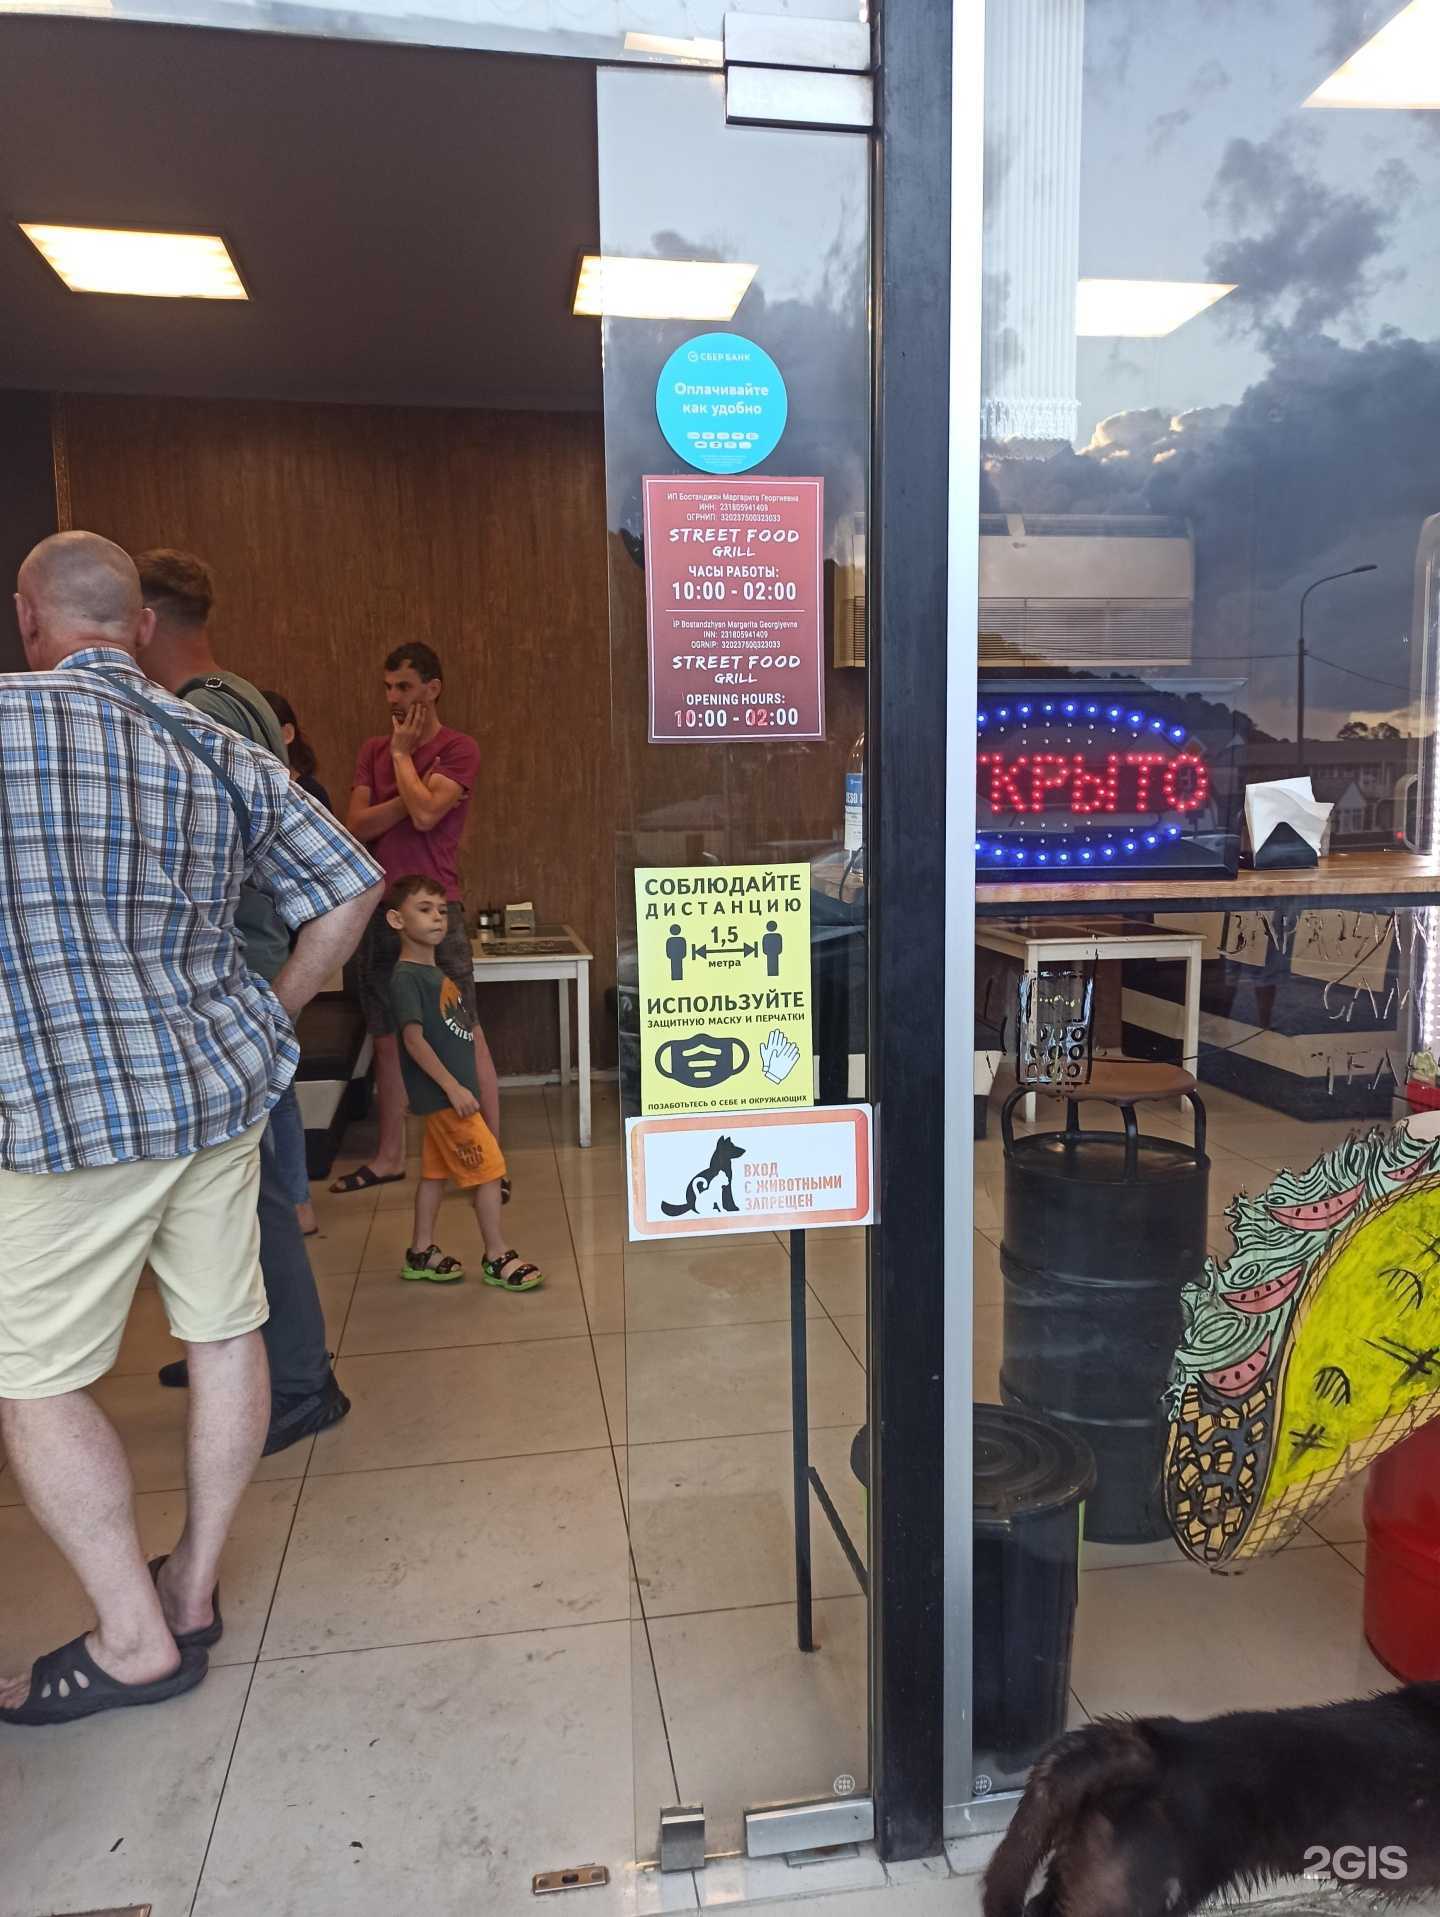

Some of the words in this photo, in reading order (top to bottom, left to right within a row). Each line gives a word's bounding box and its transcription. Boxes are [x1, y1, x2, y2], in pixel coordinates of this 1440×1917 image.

[674, 382, 769, 396] Оплачивайте
[683, 402, 707, 414] как
[712, 401, 762, 416] удобно
[723, 493, 759, 502] Маргарита
[669, 528, 740, 543] STREET
[747, 529, 800, 543] FOOD
[713, 546, 756, 557] GRILL
[689, 565, 723, 578] ЧАСЫ
[727, 565, 779, 578] РАБОТЫ:
[672, 581, 725, 600] 10:00
[744, 582, 796, 600] 02:00
[672, 655, 743, 670] STREET
[748, 656, 801, 669] FOOD
[714, 673, 758, 684] GRILL
[686, 694, 738, 705] OPENING
[742, 693, 785, 704] HOURS:
[675, 709, 726, 727] 10:00
[746, 708, 798, 726] 02:00
[644, 872, 801, 896] СОБЛЮДАЙТЕ
[645, 898, 801, 920] ДИСТАНЦИЮ
[711, 926, 738, 947] 1,5
[708, 958, 741, 969] метра
[647, 989, 804, 1015] ИСПОЛЬЗУЙТЕ
[648, 1017, 704, 1028] ЗАЩИТНУЮ
[708, 1016, 742, 1026] МАСКУ
[745, 1015, 752, 1023] И
[755, 1013, 805, 1023] ПЕРЧАТКИ
[648, 1101, 708, 1110] ПОЗАБОТЬТЕСЬ
[719, 1098, 738, 1106] СЕБЕ
[749, 1095, 807, 1104] ОКРУЖАЮЩИХ
[744, 1163, 779, 1177] ВХОД
[744, 1181, 752, 1193] С
[756, 1176, 842, 1193] ЖИВОТНЫМИ
[745, 1194, 813, 1210] ЗАПРЕЩЕН
